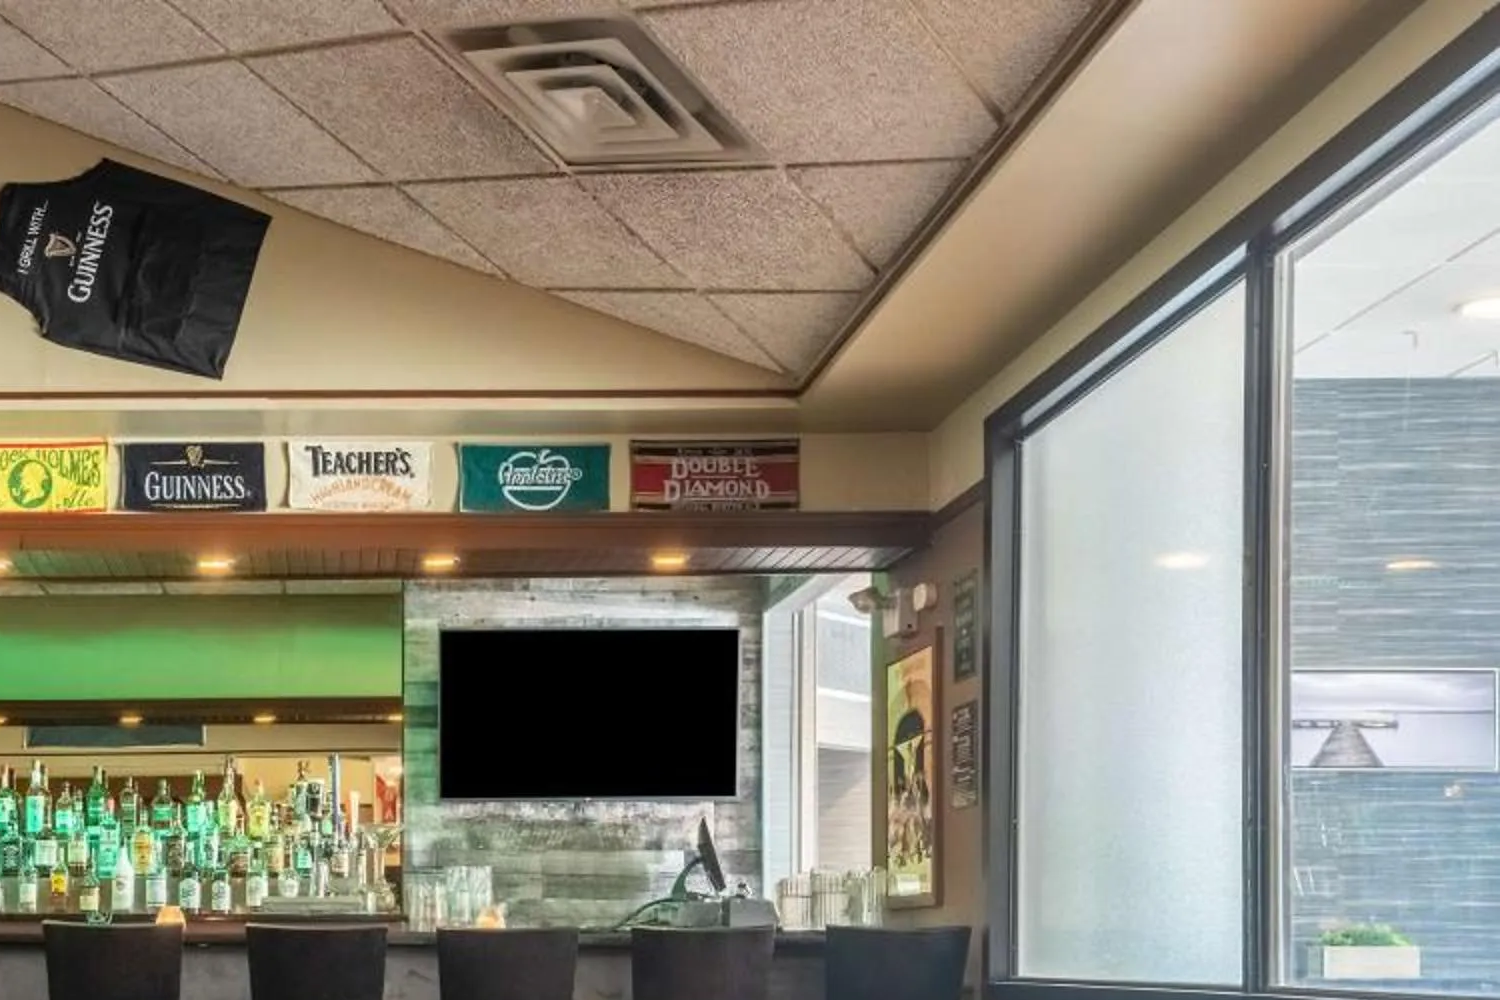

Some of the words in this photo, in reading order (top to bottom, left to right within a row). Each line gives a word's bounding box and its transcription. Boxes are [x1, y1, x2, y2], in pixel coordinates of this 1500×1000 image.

[67, 199, 113, 303] GUINNESS
[671, 457, 762, 479] DOUBLE
[144, 471, 245, 501] GUINNESS
[663, 480, 770, 502] DIAMOND
